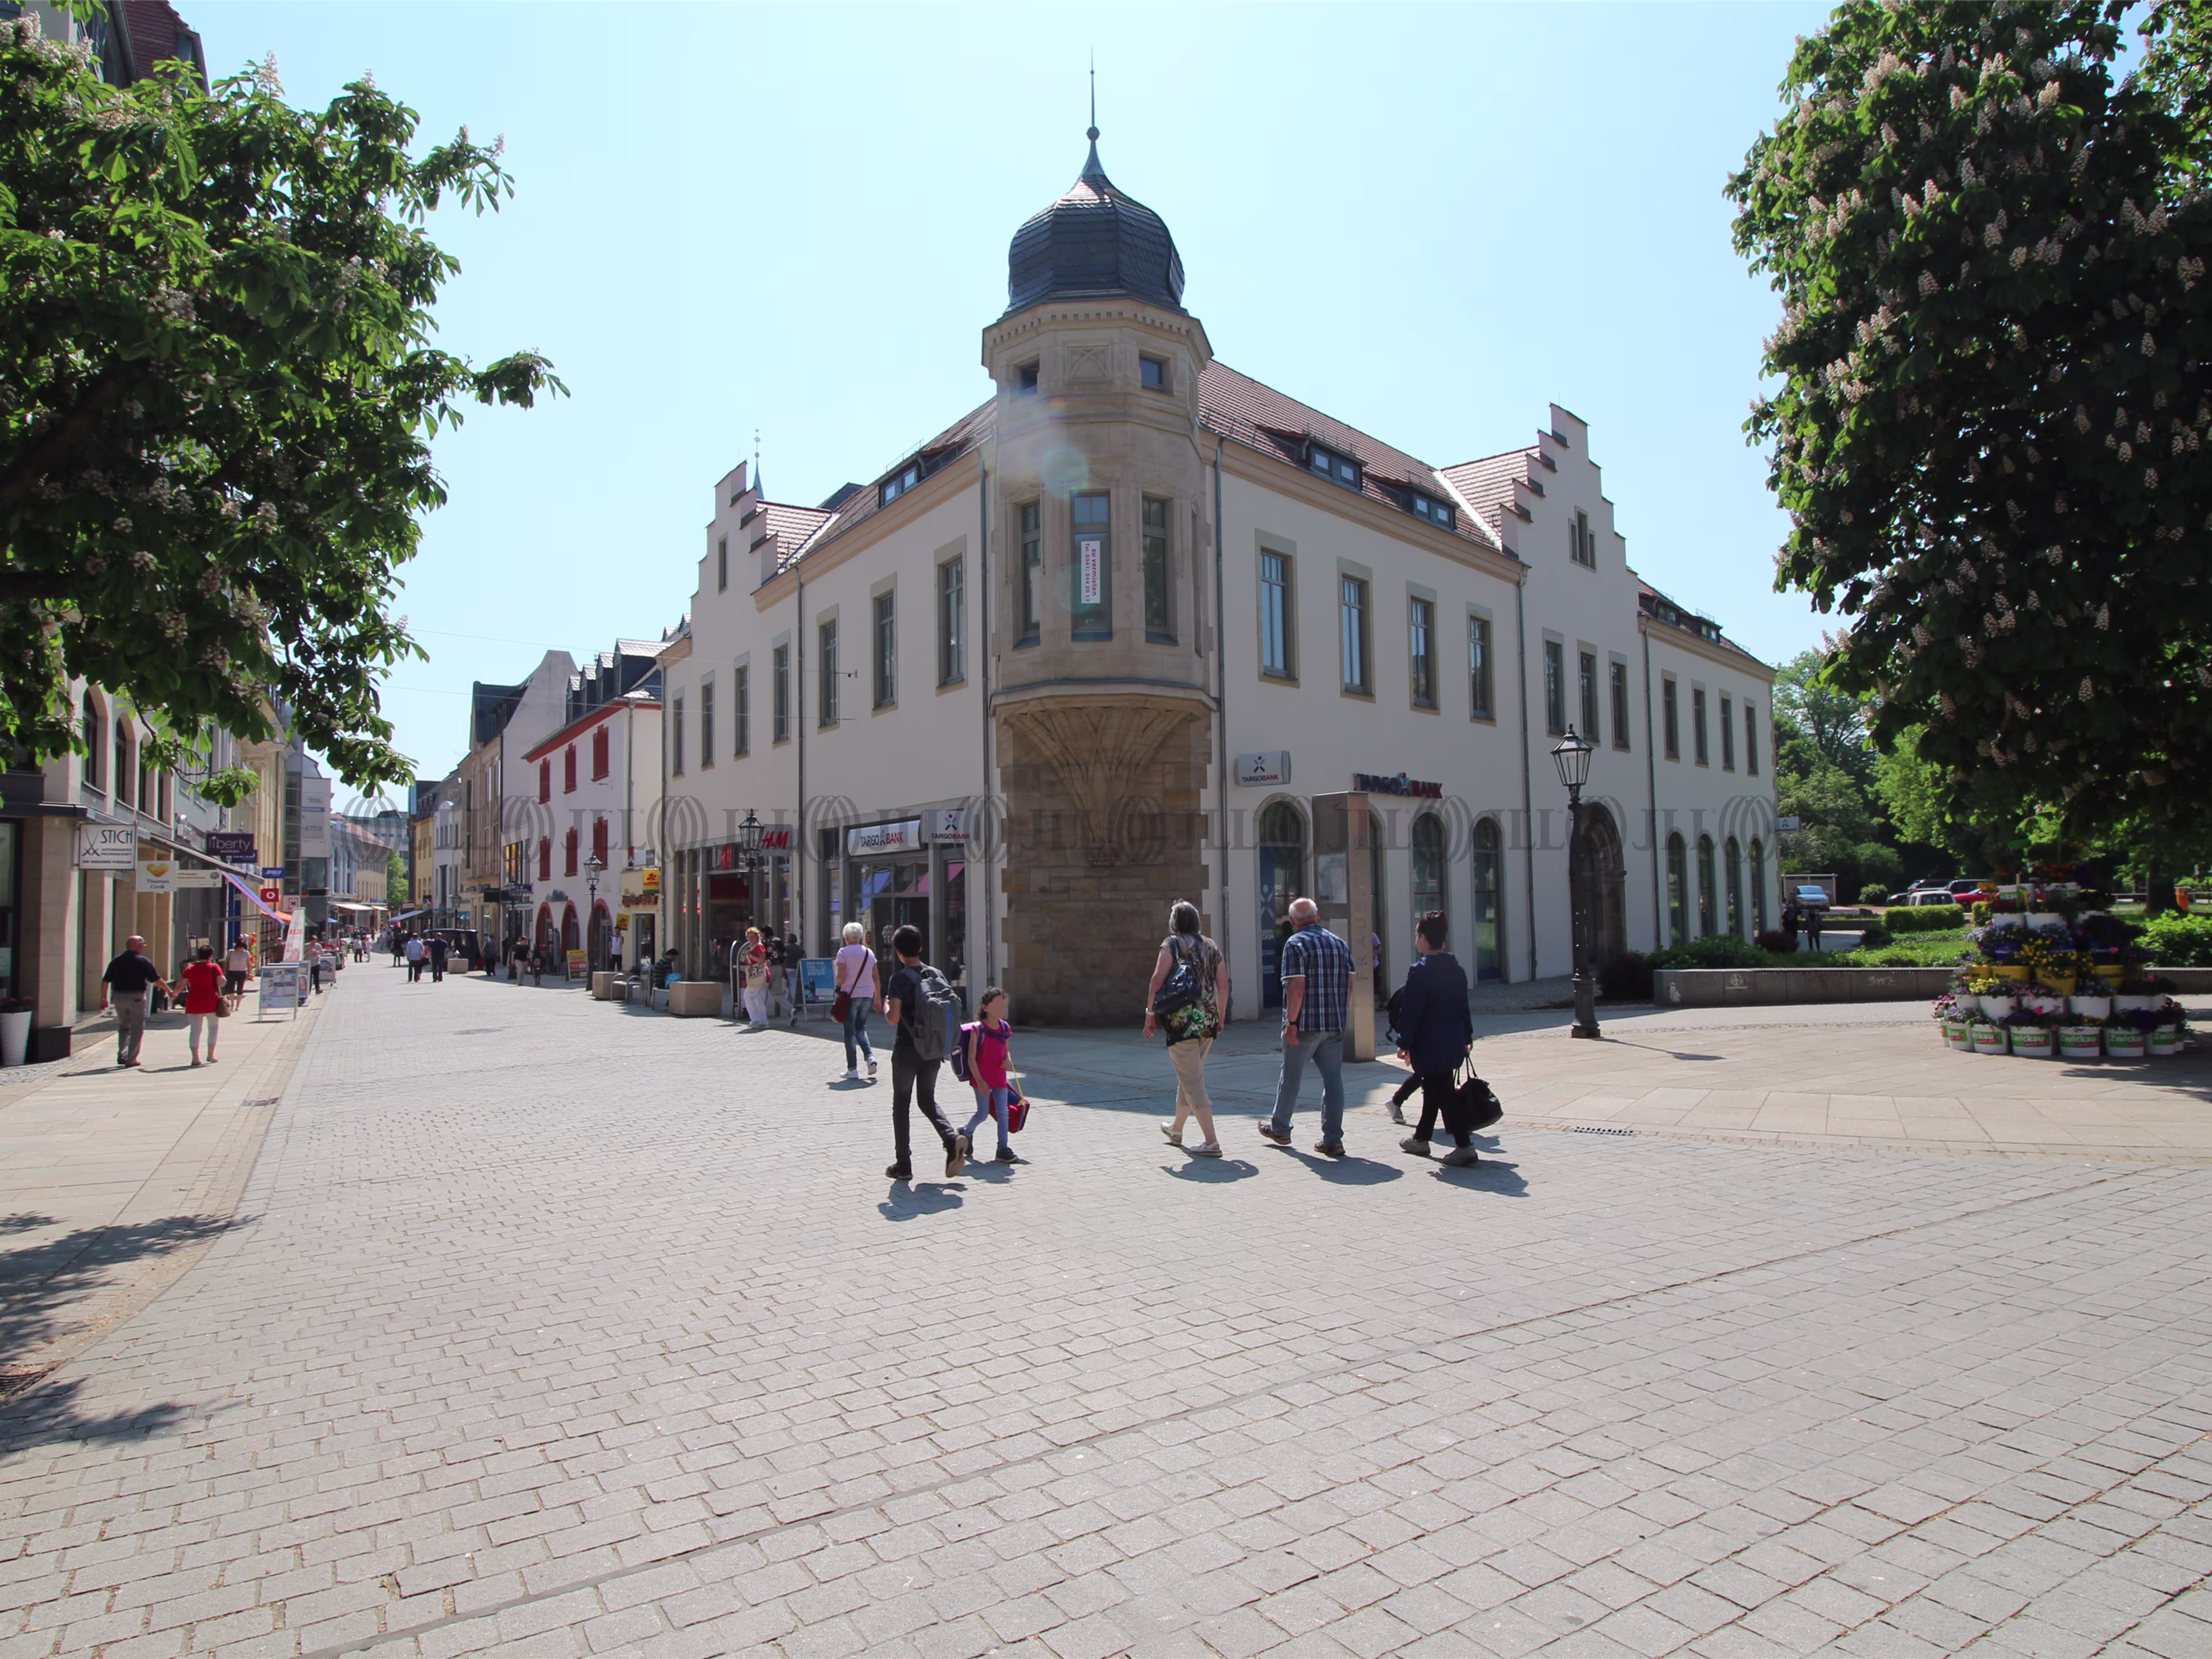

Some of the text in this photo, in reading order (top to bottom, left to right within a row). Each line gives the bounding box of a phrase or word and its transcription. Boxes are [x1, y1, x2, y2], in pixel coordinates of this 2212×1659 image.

[1092, 548, 1096, 557] zu
[1241, 774, 1279, 783] TARGOBANK
[100, 830, 132, 844] STICH
[209, 836, 251, 851] liberty
[762, 831, 789, 849] H&M
